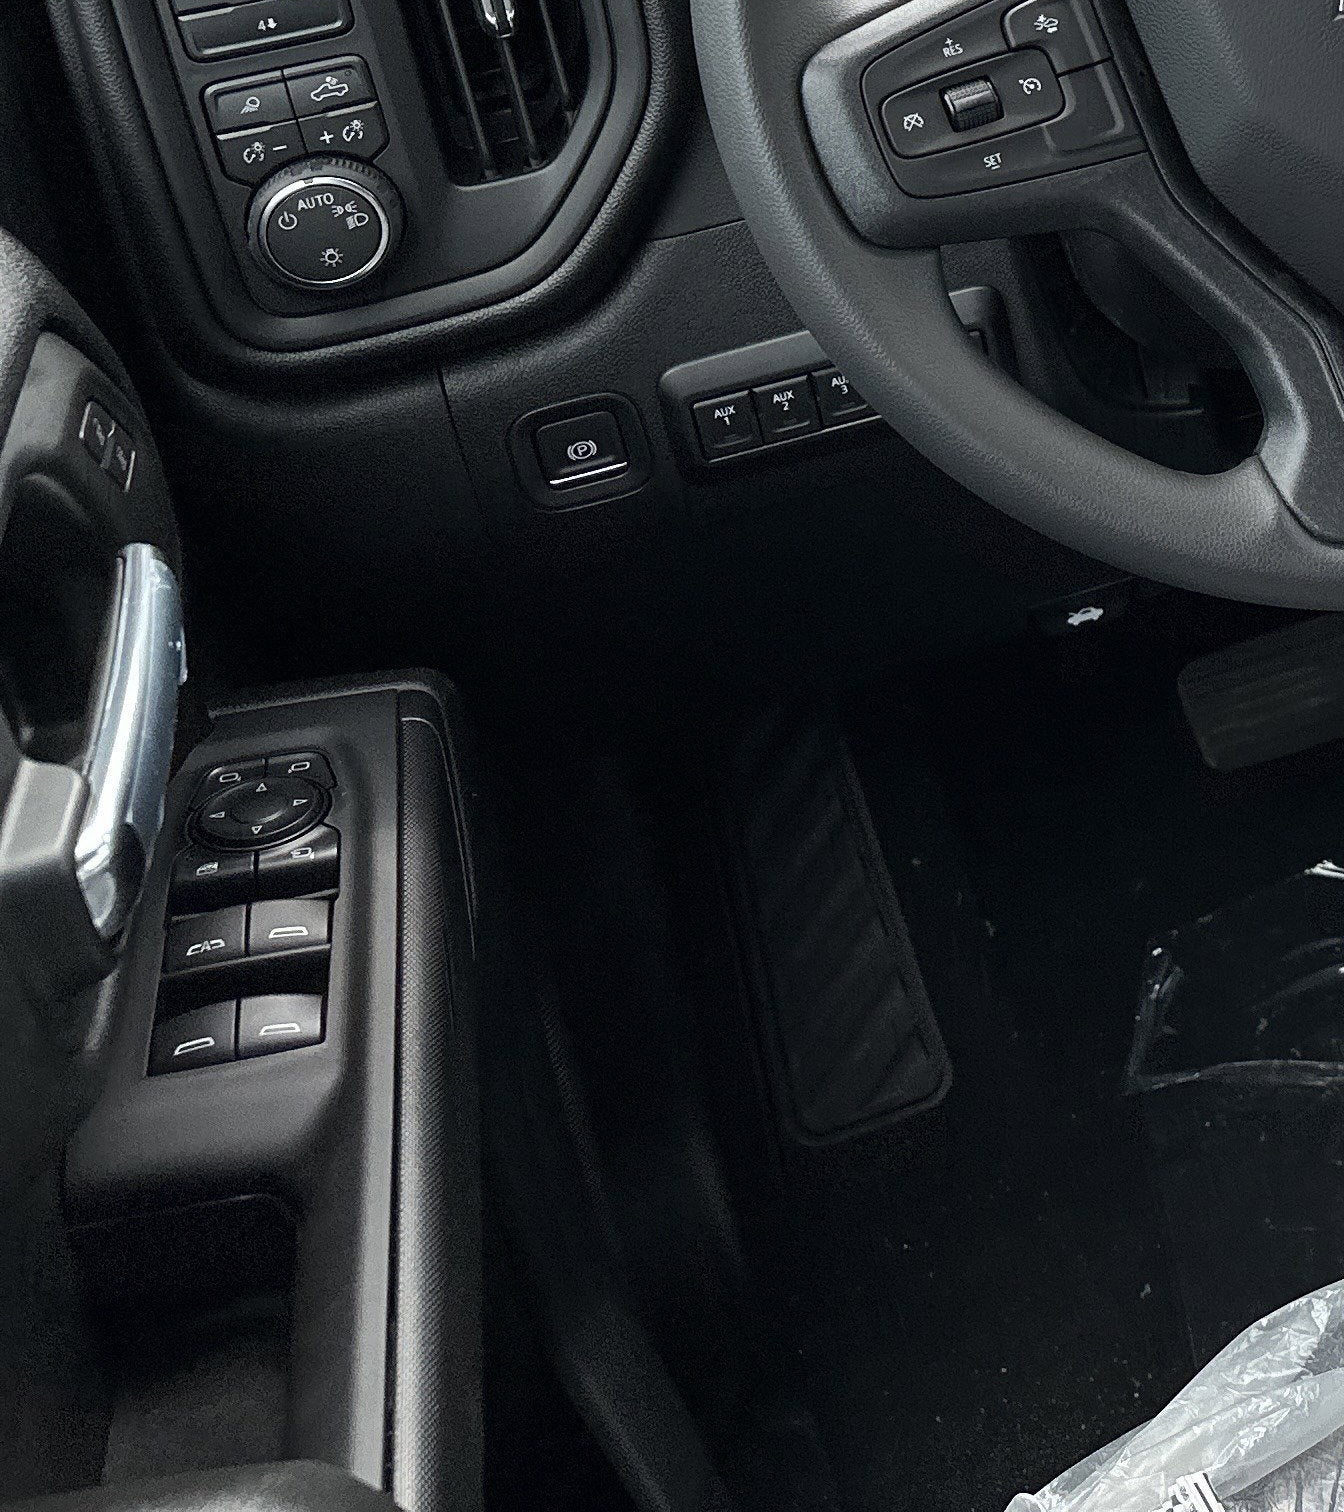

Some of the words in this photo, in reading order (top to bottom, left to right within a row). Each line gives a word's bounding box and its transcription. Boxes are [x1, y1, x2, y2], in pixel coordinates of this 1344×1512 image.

[942, 43, 964, 58] RES
[983, 152, 1002, 167] SET
[298, 192, 334, 211] AUTO
[831, 374, 850, 387] AU
[772, 389, 795, 404] AUX
[841, 384, 849, 395] 3
[714, 405, 736, 419] AUX
[782, 401, 790, 411] 2
[723, 415, 731, 426] 1
